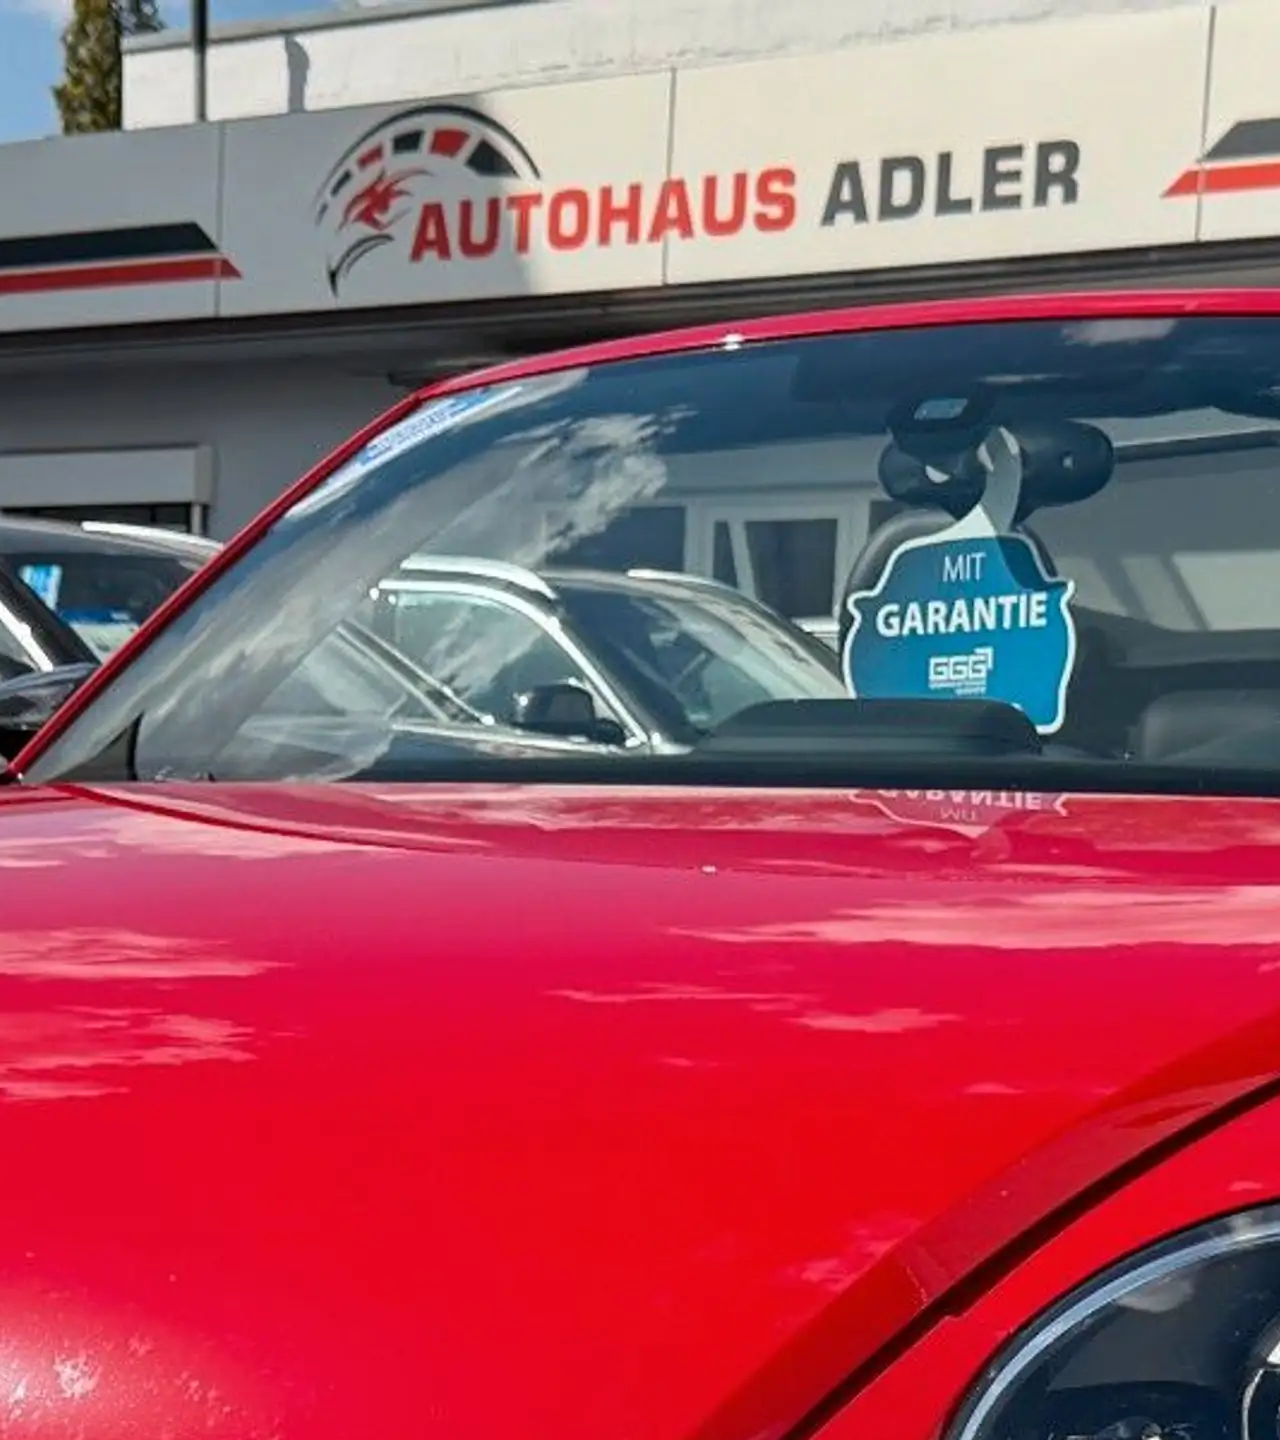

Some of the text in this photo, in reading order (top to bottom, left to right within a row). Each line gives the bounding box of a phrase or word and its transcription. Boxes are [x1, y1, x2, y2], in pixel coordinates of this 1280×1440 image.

[410, 140, 1080, 262] AUTOHAUS ADLER
[942, 552, 986, 582] MIT
[876, 592, 1048, 638] GARANTIE
